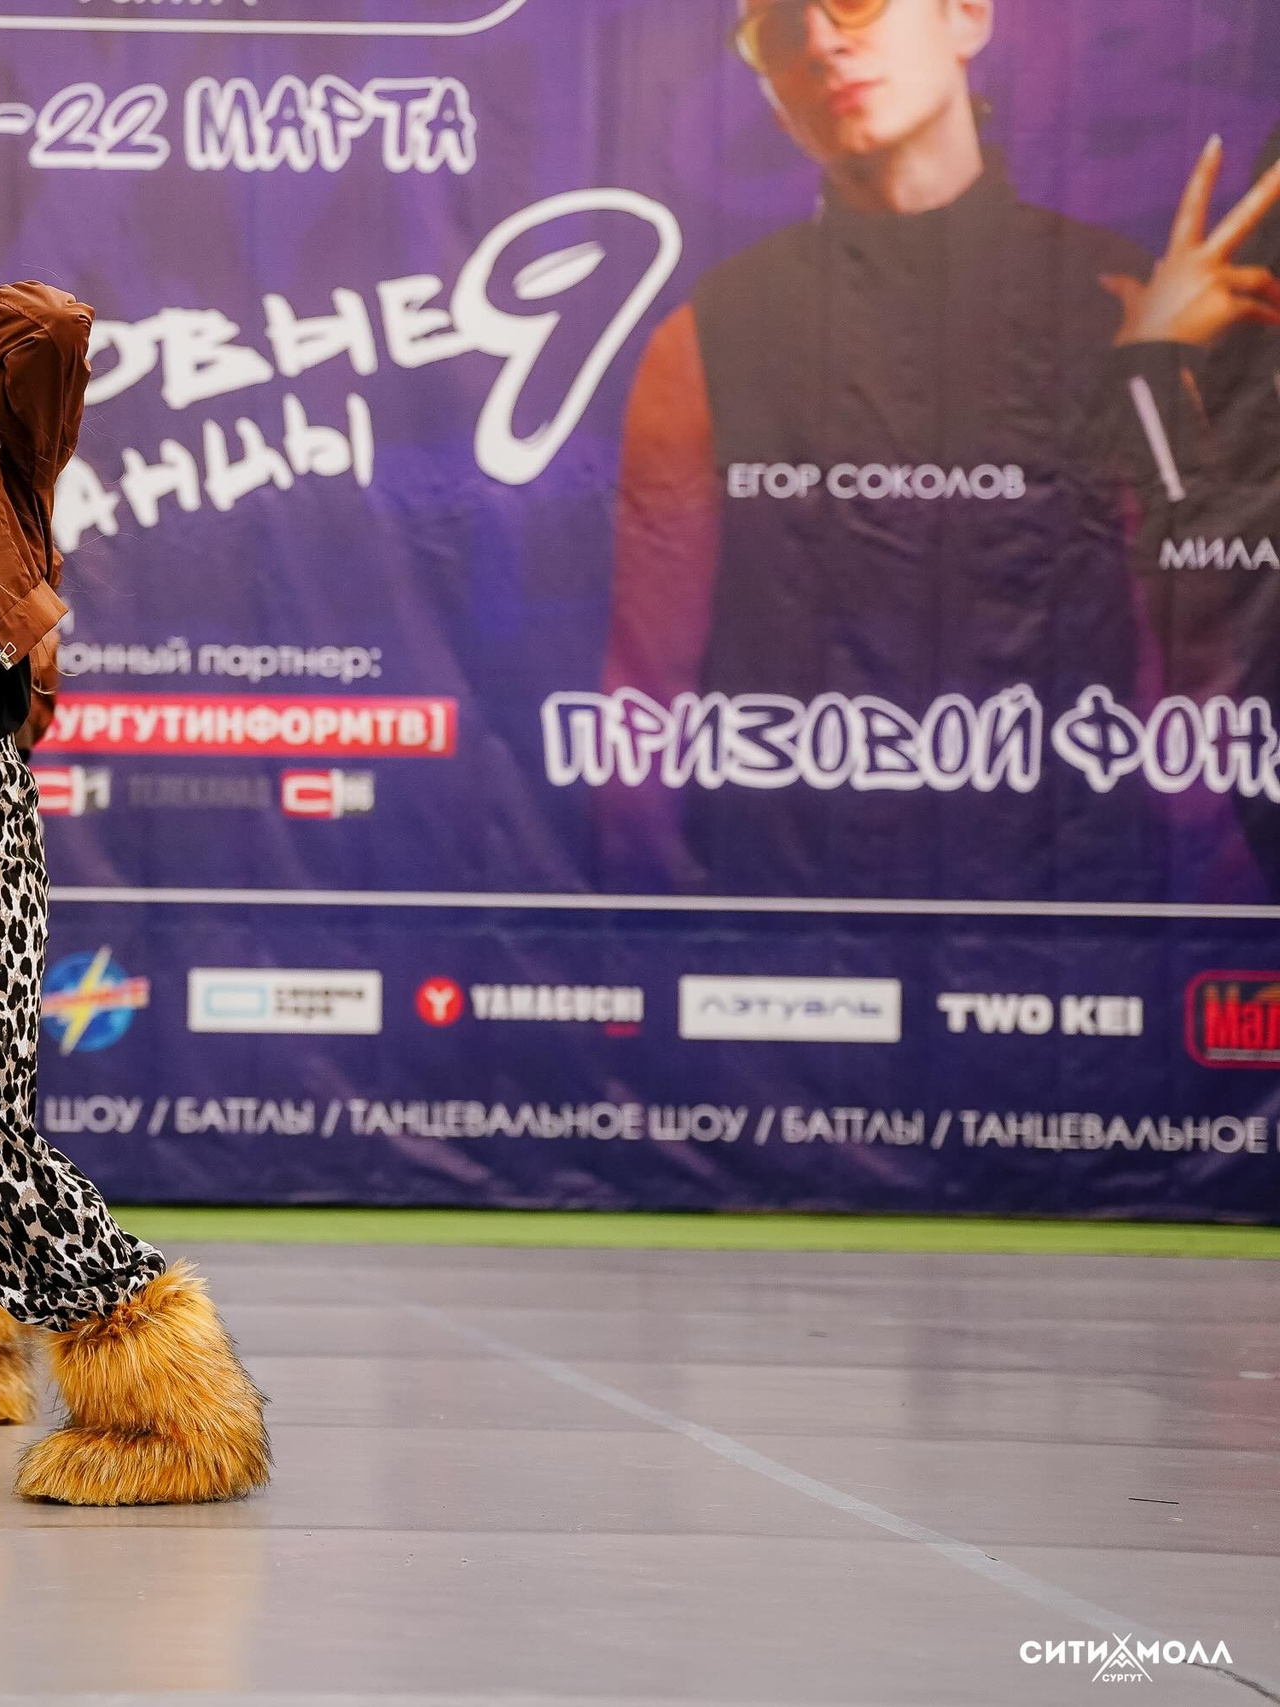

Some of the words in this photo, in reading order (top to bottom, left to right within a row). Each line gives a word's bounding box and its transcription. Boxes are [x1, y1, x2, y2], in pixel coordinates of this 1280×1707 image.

[184, 74, 477, 175] МАРТА
[83, 273, 465, 410] ОВЫЕ
[52, 393, 375, 554] АНЦЫ
[726, 462, 822, 500] ЕГОР
[825, 463, 1028, 501] СОКОЛОВ
[1158, 535, 1280, 570] МИЛА
[541, 685, 1043, 793] ПРИЗОВОЙ
[1051, 683, 1280, 803] ФОН
[937, 993, 1054, 1034] TWO
[1061, 996, 1143, 1036] KEI
[44, 1096, 143, 1135] ШОУ
[349, 1099, 644, 1141] ТАНЦЕВАЛЬНОЕ
[648, 1104, 747, 1143] ШОУ
[958, 1111, 1268, 1154] ТАНЦЕВАЛЬНОЕ
